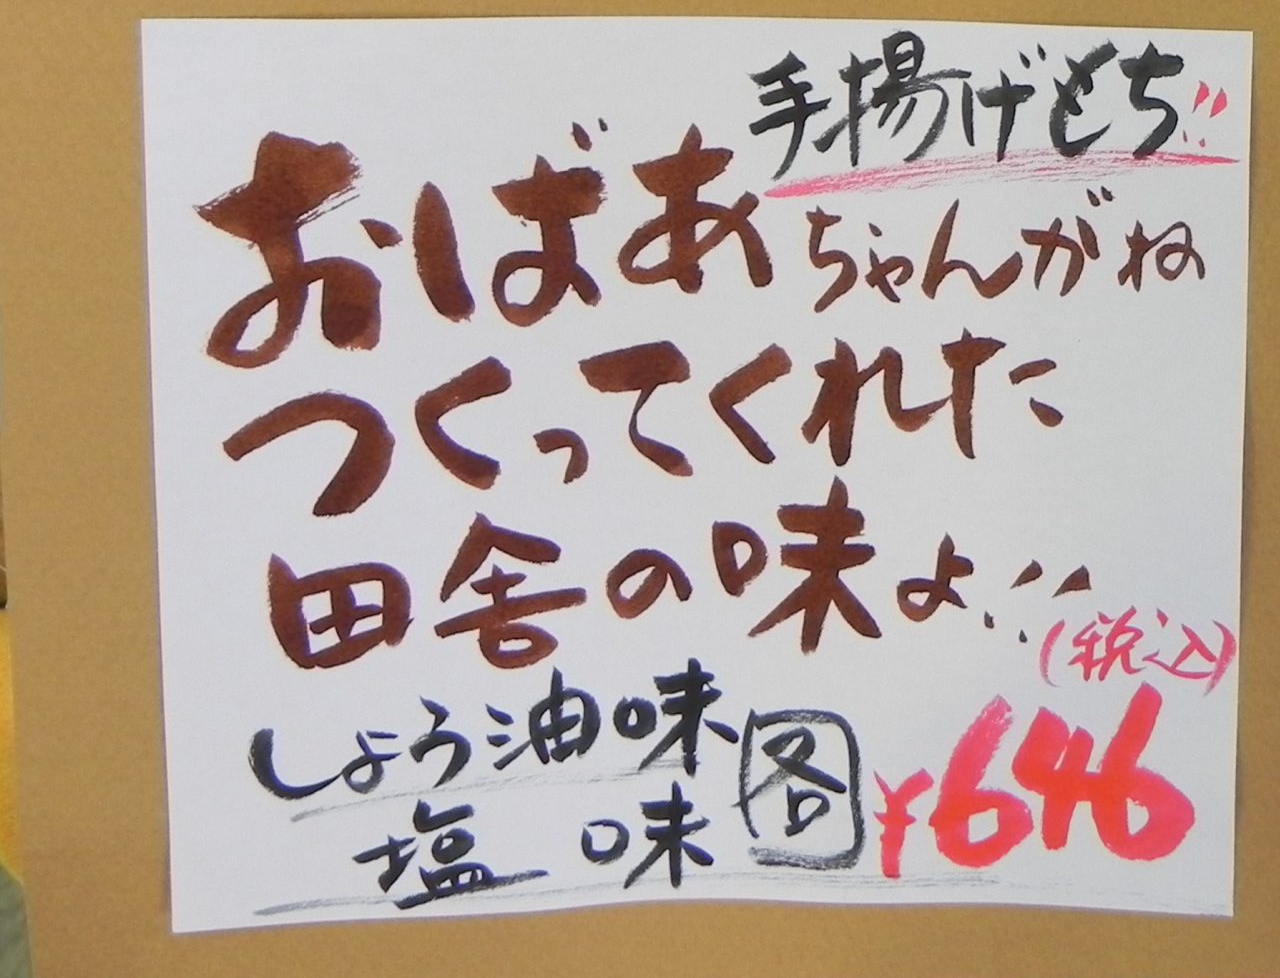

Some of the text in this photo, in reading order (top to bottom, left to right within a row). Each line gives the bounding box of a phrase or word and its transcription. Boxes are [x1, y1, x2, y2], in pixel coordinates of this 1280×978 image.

[193, 119, 1206, 368] おばあちゃんがね
[222, 327, 1064, 517] つくってくれた
[247, 658, 739, 800] しょう油味
[873, 681, 1196, 879] ¥646
